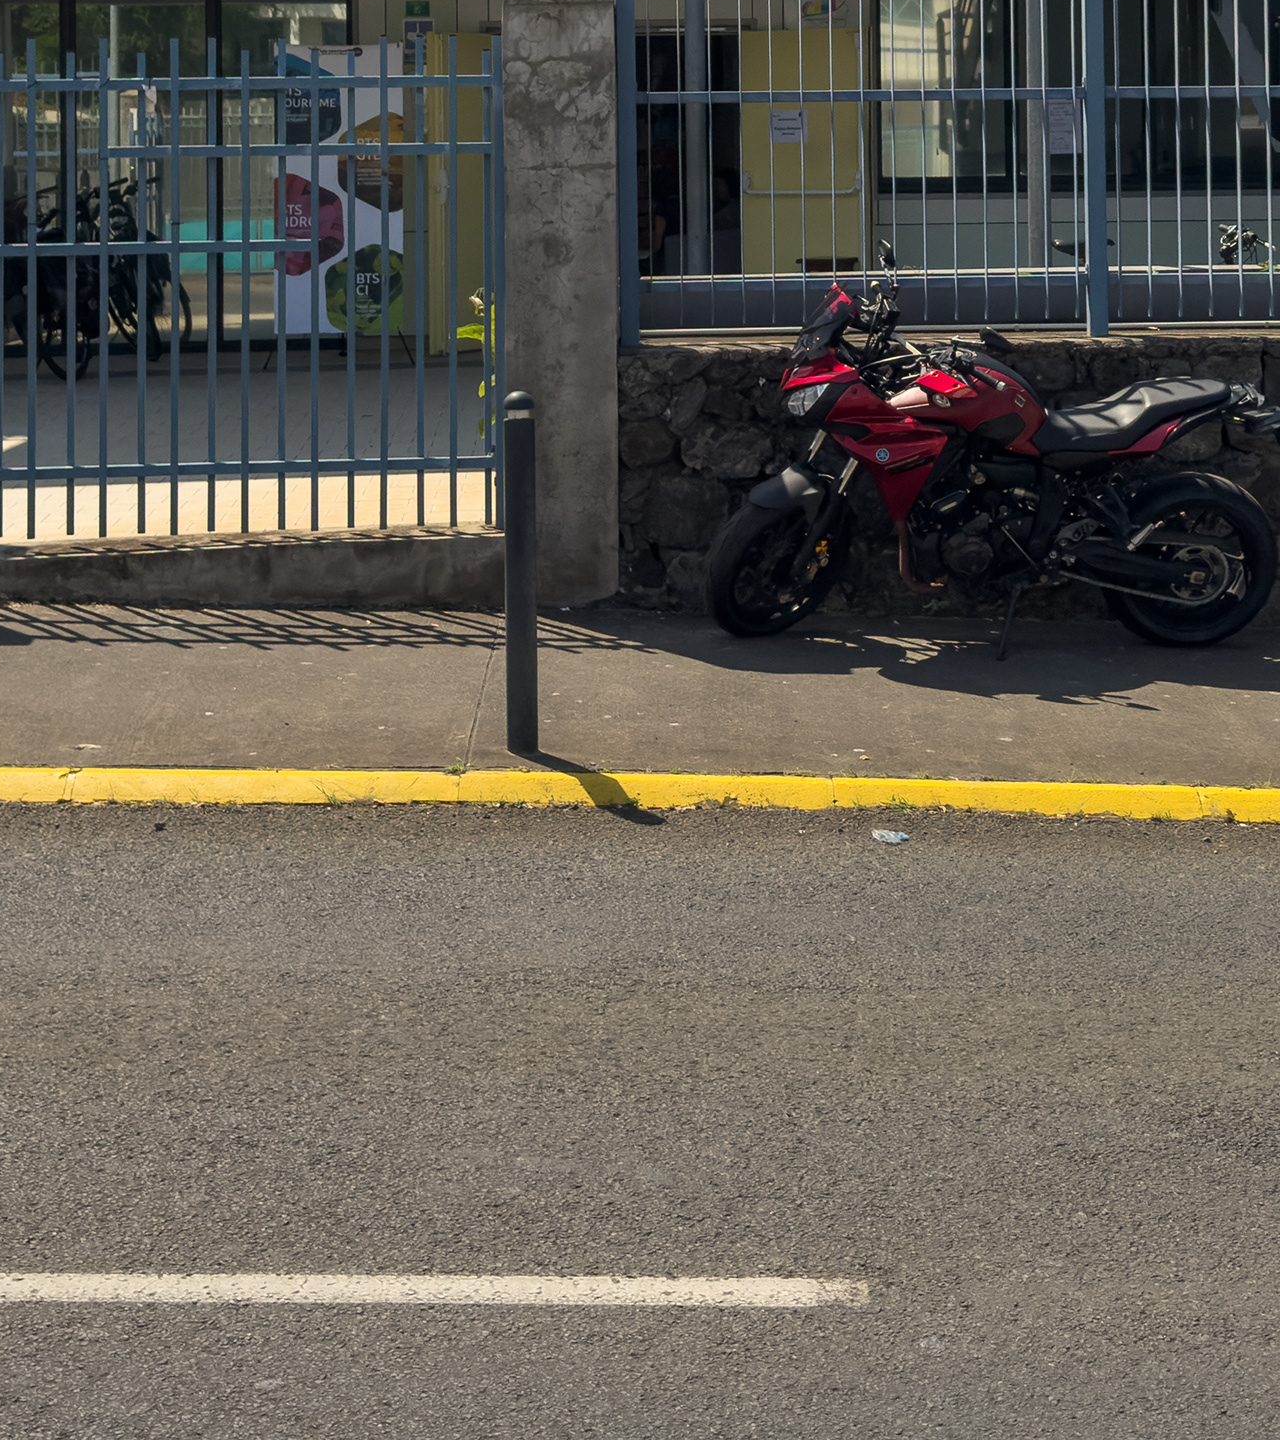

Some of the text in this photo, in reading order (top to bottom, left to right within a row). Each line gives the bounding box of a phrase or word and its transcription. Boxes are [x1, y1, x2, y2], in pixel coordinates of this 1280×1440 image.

[287, 203, 303, 216] TS
[356, 273, 381, 284] BTS
[356, 284, 369, 296] CI
